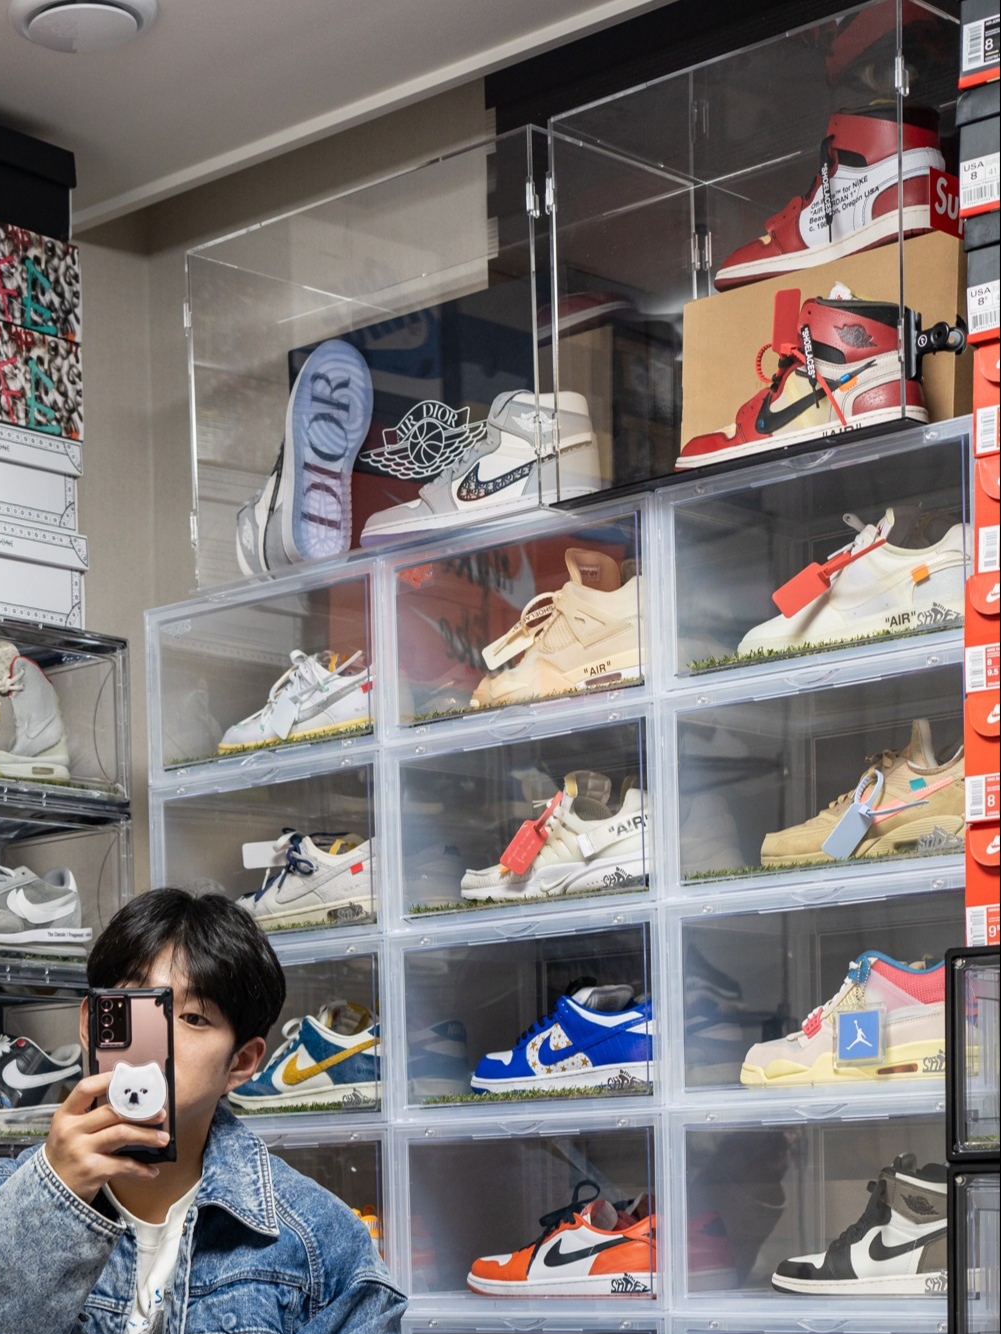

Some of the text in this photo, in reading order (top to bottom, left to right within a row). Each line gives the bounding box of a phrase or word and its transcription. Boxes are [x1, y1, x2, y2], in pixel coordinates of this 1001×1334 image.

[985, 38, 994, 51] 8
[963, 161, 984, 172] USA
[970, 171, 978, 180] 8
[842, 185, 854, 195] for
[853, 175, 868, 188] NIKE
[842, 195, 863, 211] Oregon
[970, 286, 991, 298] USA
[801, 327, 816, 379] "SHOELACES"
[396, 403, 459, 443] AIR DIOR
[301, 372, 351, 531] DIOR
[987, 794, 996, 807] 8
